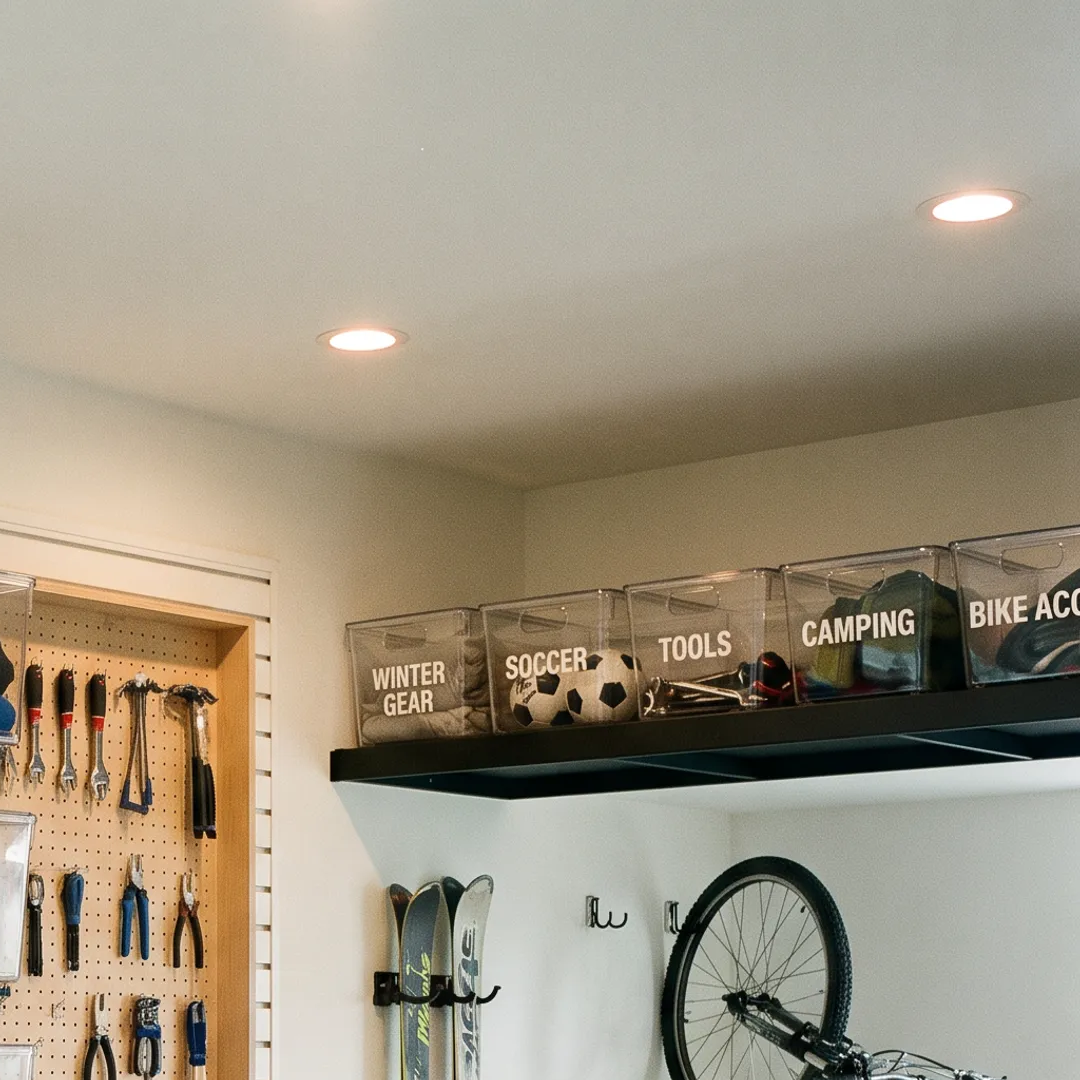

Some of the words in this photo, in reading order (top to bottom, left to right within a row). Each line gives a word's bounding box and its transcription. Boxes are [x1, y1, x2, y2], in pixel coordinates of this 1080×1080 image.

[970, 595, 1028, 628] BIKE
[802, 609, 914, 647] CAMPING
[658, 631, 731, 662] TOOLS
[373, 662, 445, 689] WINTER
[505, 647, 587, 679] SOCCER
[384, 690, 434, 715] GEAR
